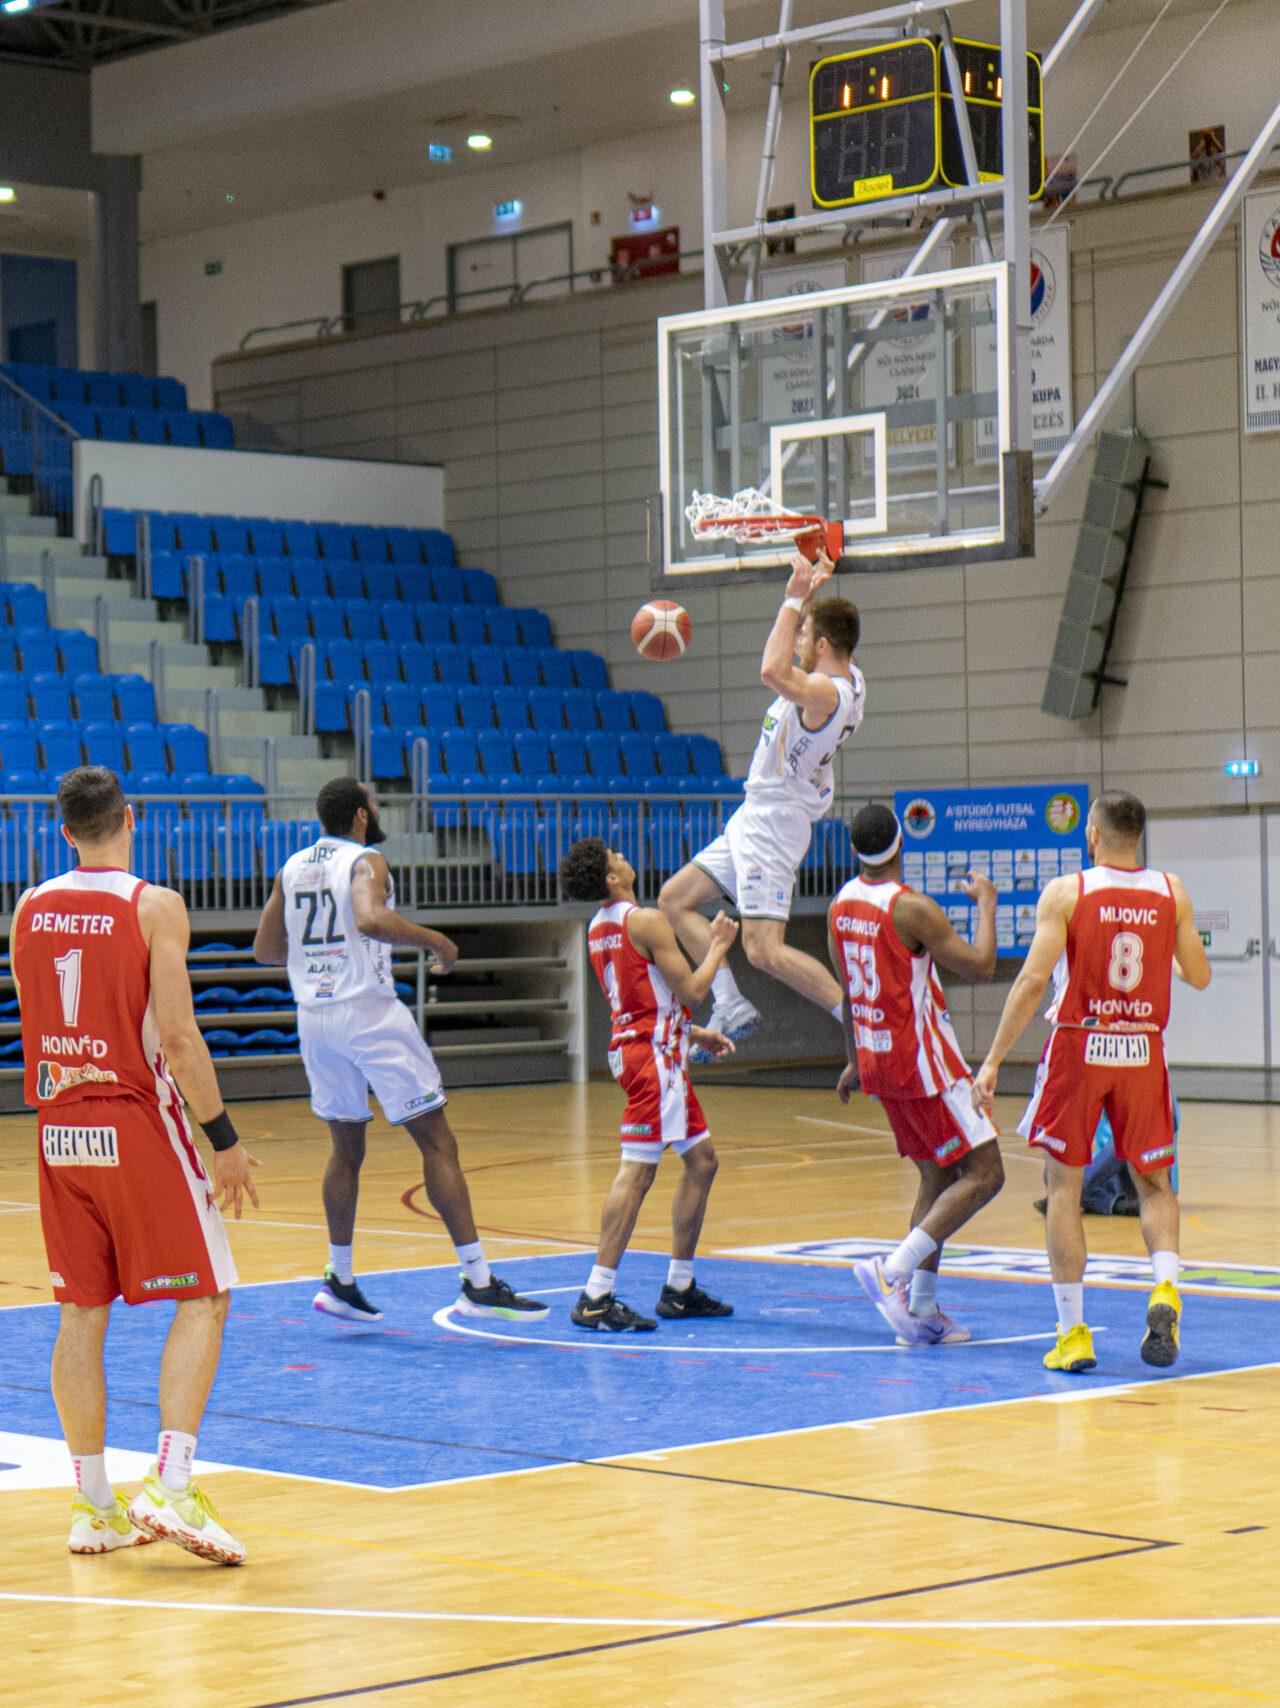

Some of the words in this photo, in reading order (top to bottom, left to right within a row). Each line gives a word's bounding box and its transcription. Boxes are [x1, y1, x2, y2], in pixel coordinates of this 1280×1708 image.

[1032, 387, 1061, 403] KUPA
[1033, 410, 1064, 430] EZÉS
[995, 802, 1035, 817] FUTSAL
[31, 912, 114, 935] DEMETER
[295, 888, 345, 945] 22
[1099, 906, 1158, 925] MIJOVIC
[836, 916, 881, 937] CRAWLEY
[843, 941, 880, 1001] 53
[1109, 931, 1144, 993] 8
[54, 949, 82, 1028] 1
[1089, 998, 1153, 1018] HONVÉD
